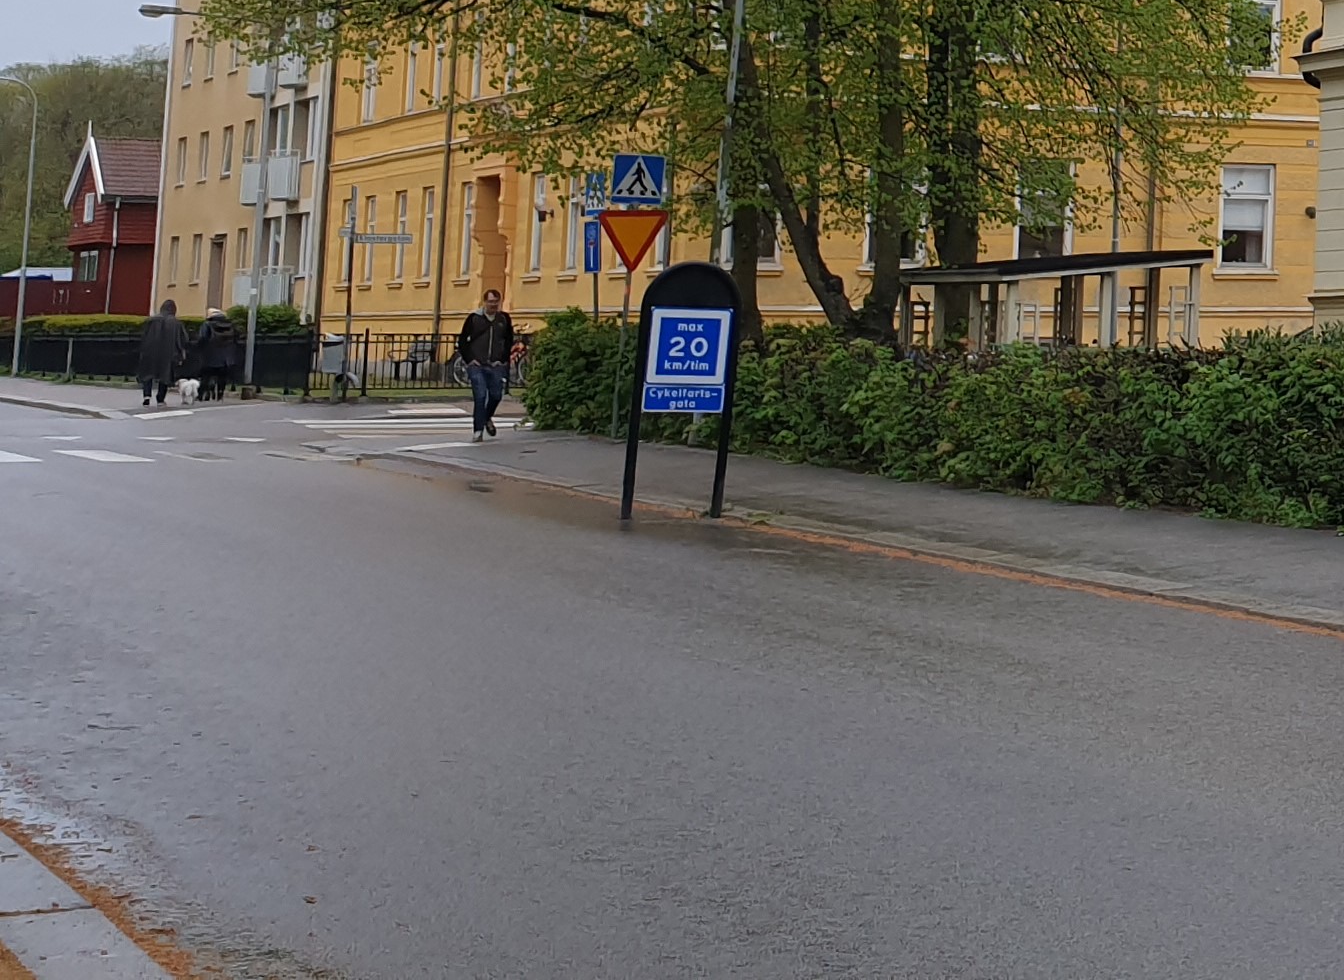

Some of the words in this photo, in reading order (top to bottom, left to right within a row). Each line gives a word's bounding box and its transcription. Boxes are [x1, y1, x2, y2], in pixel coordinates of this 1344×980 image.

[677, 323, 704, 332] max
[668, 336, 708, 357] 20
[664, 360, 709, 371] km/tim
[649, 387, 718, 399] Cykelfarts-
[669, 400, 696, 410] gata
